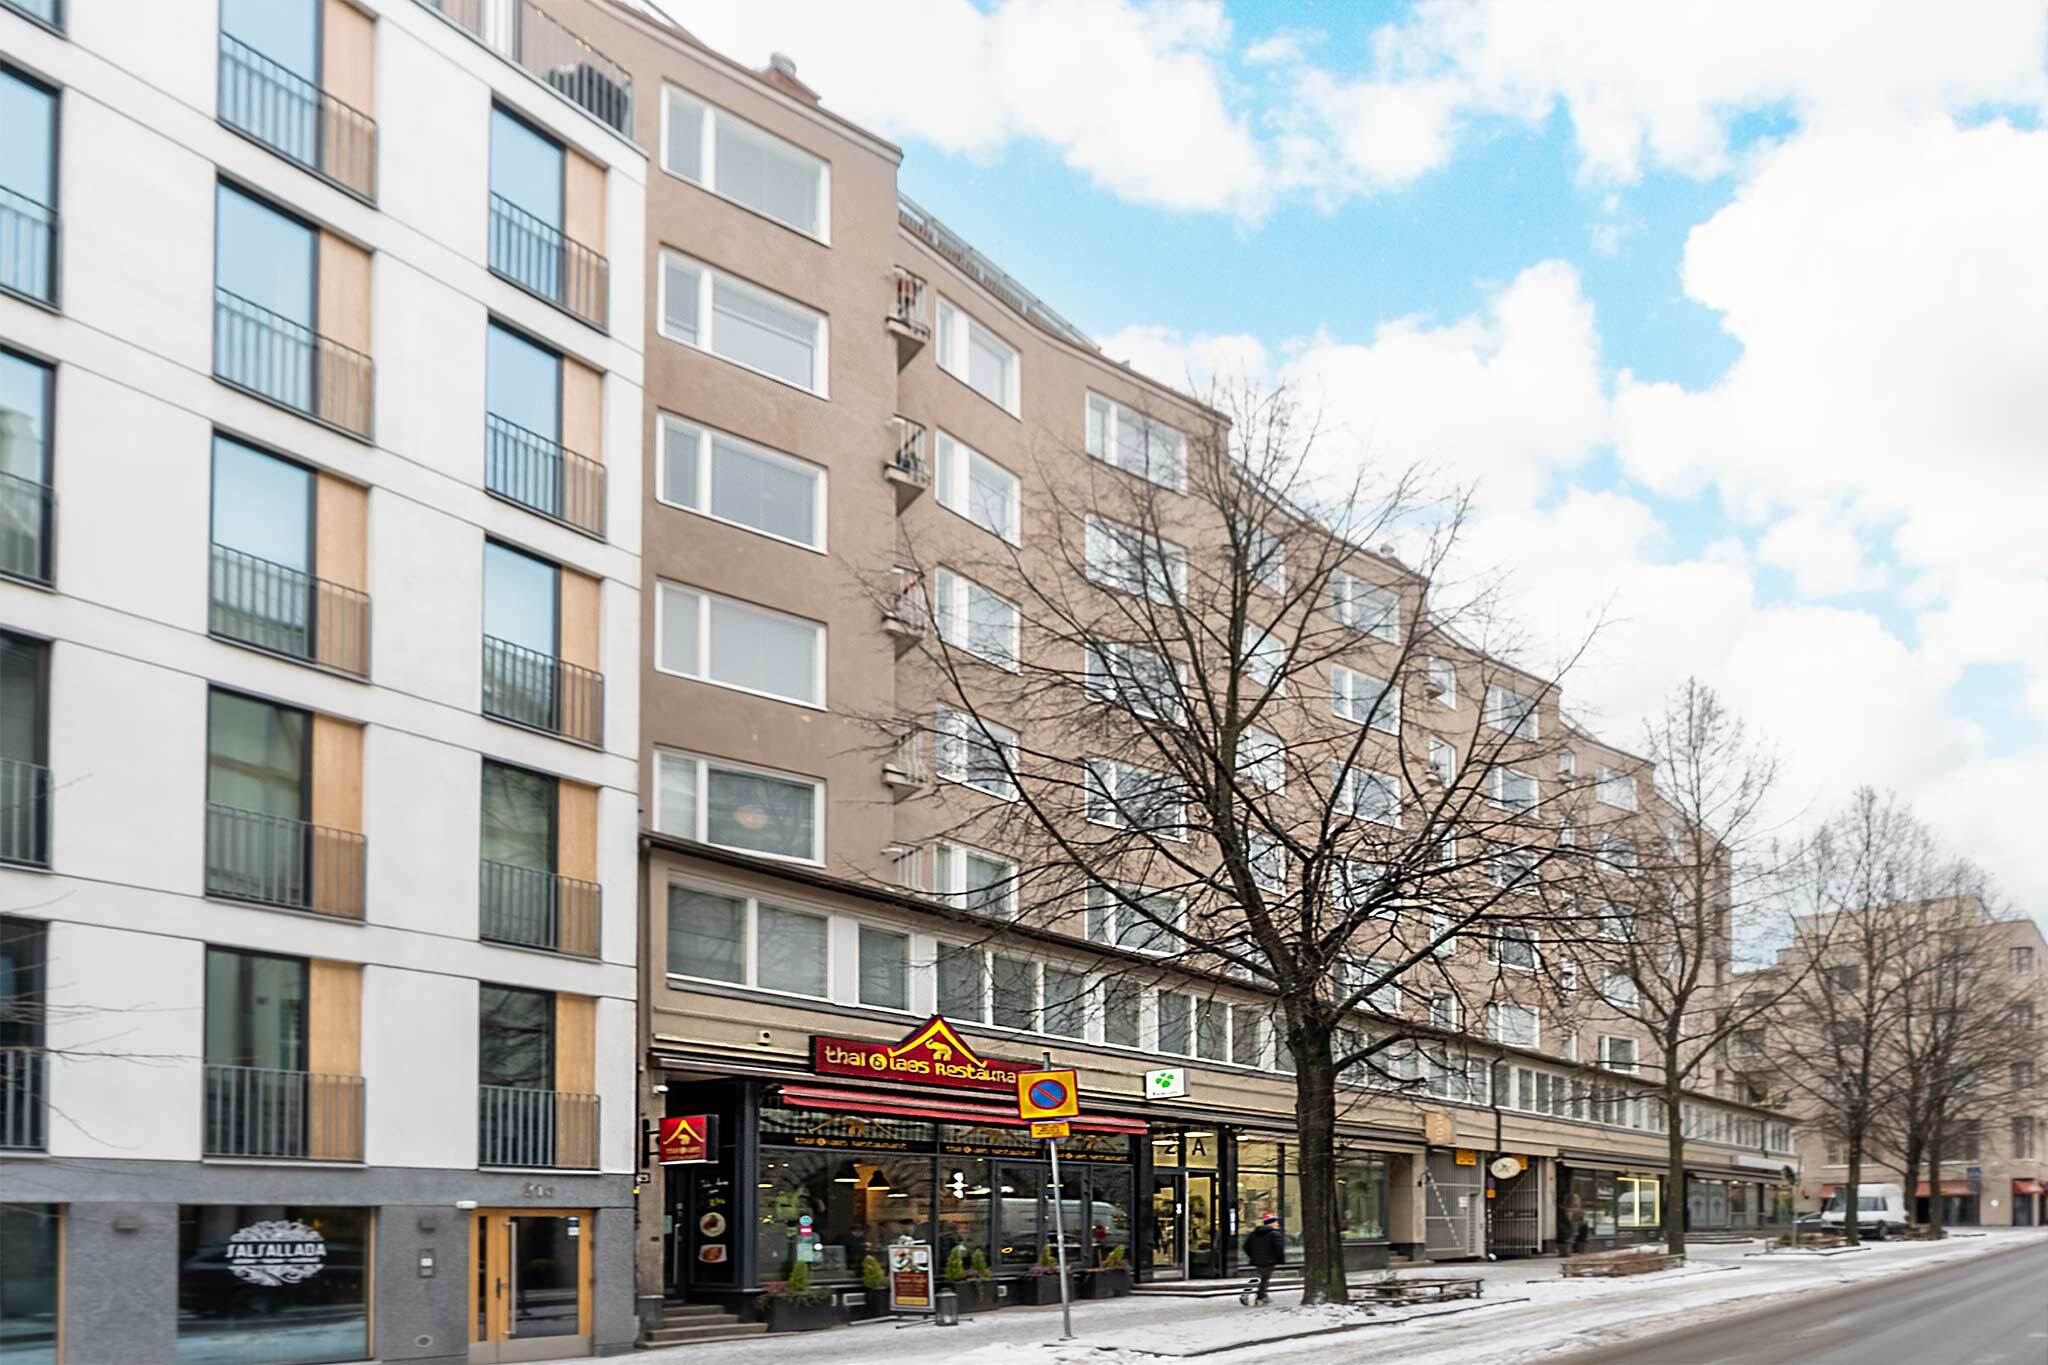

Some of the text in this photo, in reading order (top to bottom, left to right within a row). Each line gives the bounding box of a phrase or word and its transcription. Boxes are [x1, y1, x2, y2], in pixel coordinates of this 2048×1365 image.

[935, 1062, 1017, 1084] Restaura
[1191, 1138, 1206, 1157] A
[225, 1243, 327, 1258] SALSALLADA
